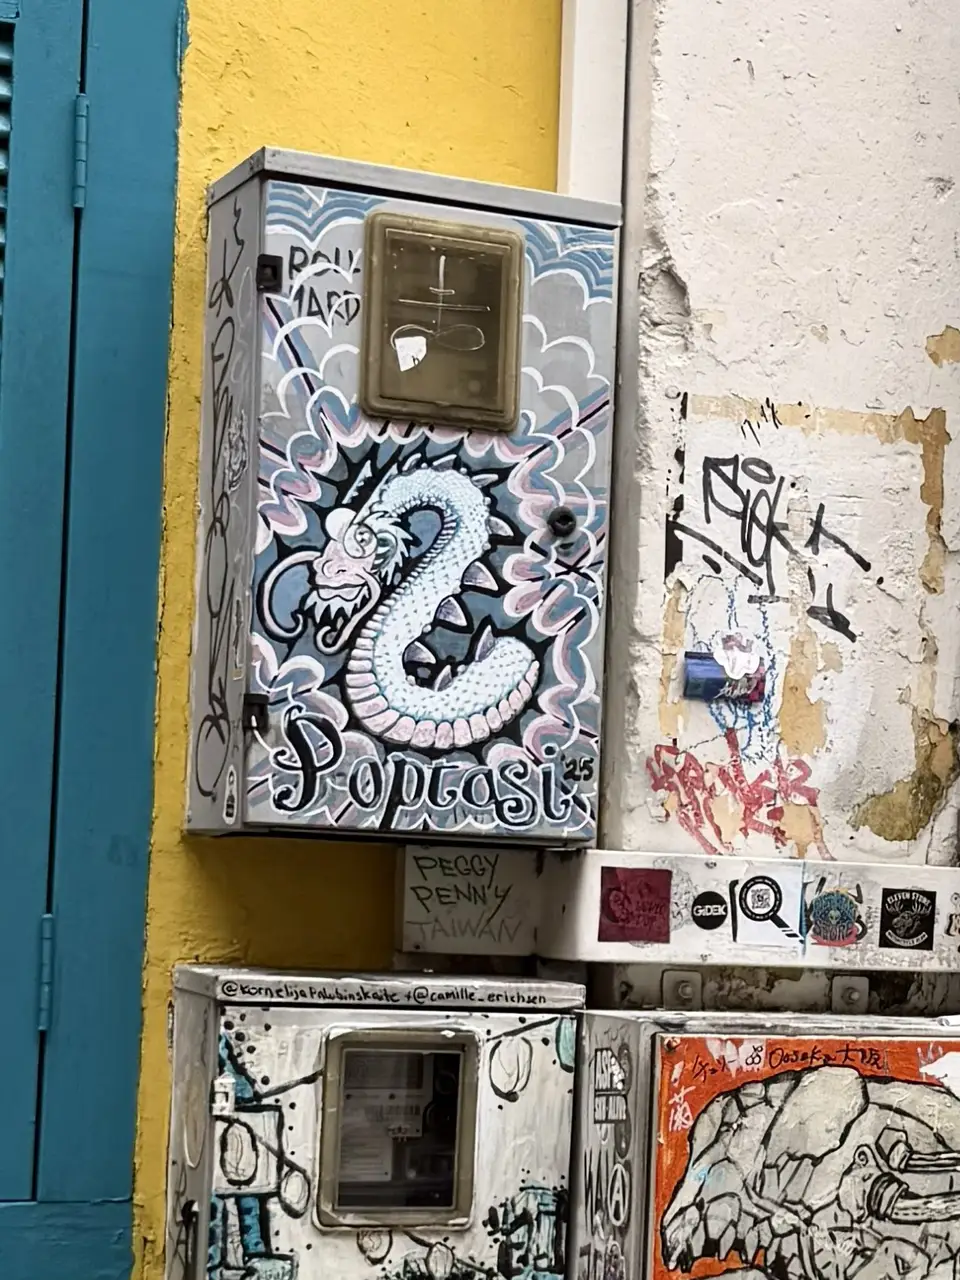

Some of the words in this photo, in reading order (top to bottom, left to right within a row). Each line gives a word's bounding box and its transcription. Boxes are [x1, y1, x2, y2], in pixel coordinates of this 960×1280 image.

[269, 705, 578, 830] Poptasi
[413, 854, 500, 891] PEGGY
[406, 917, 522, 945] TAIWAN
